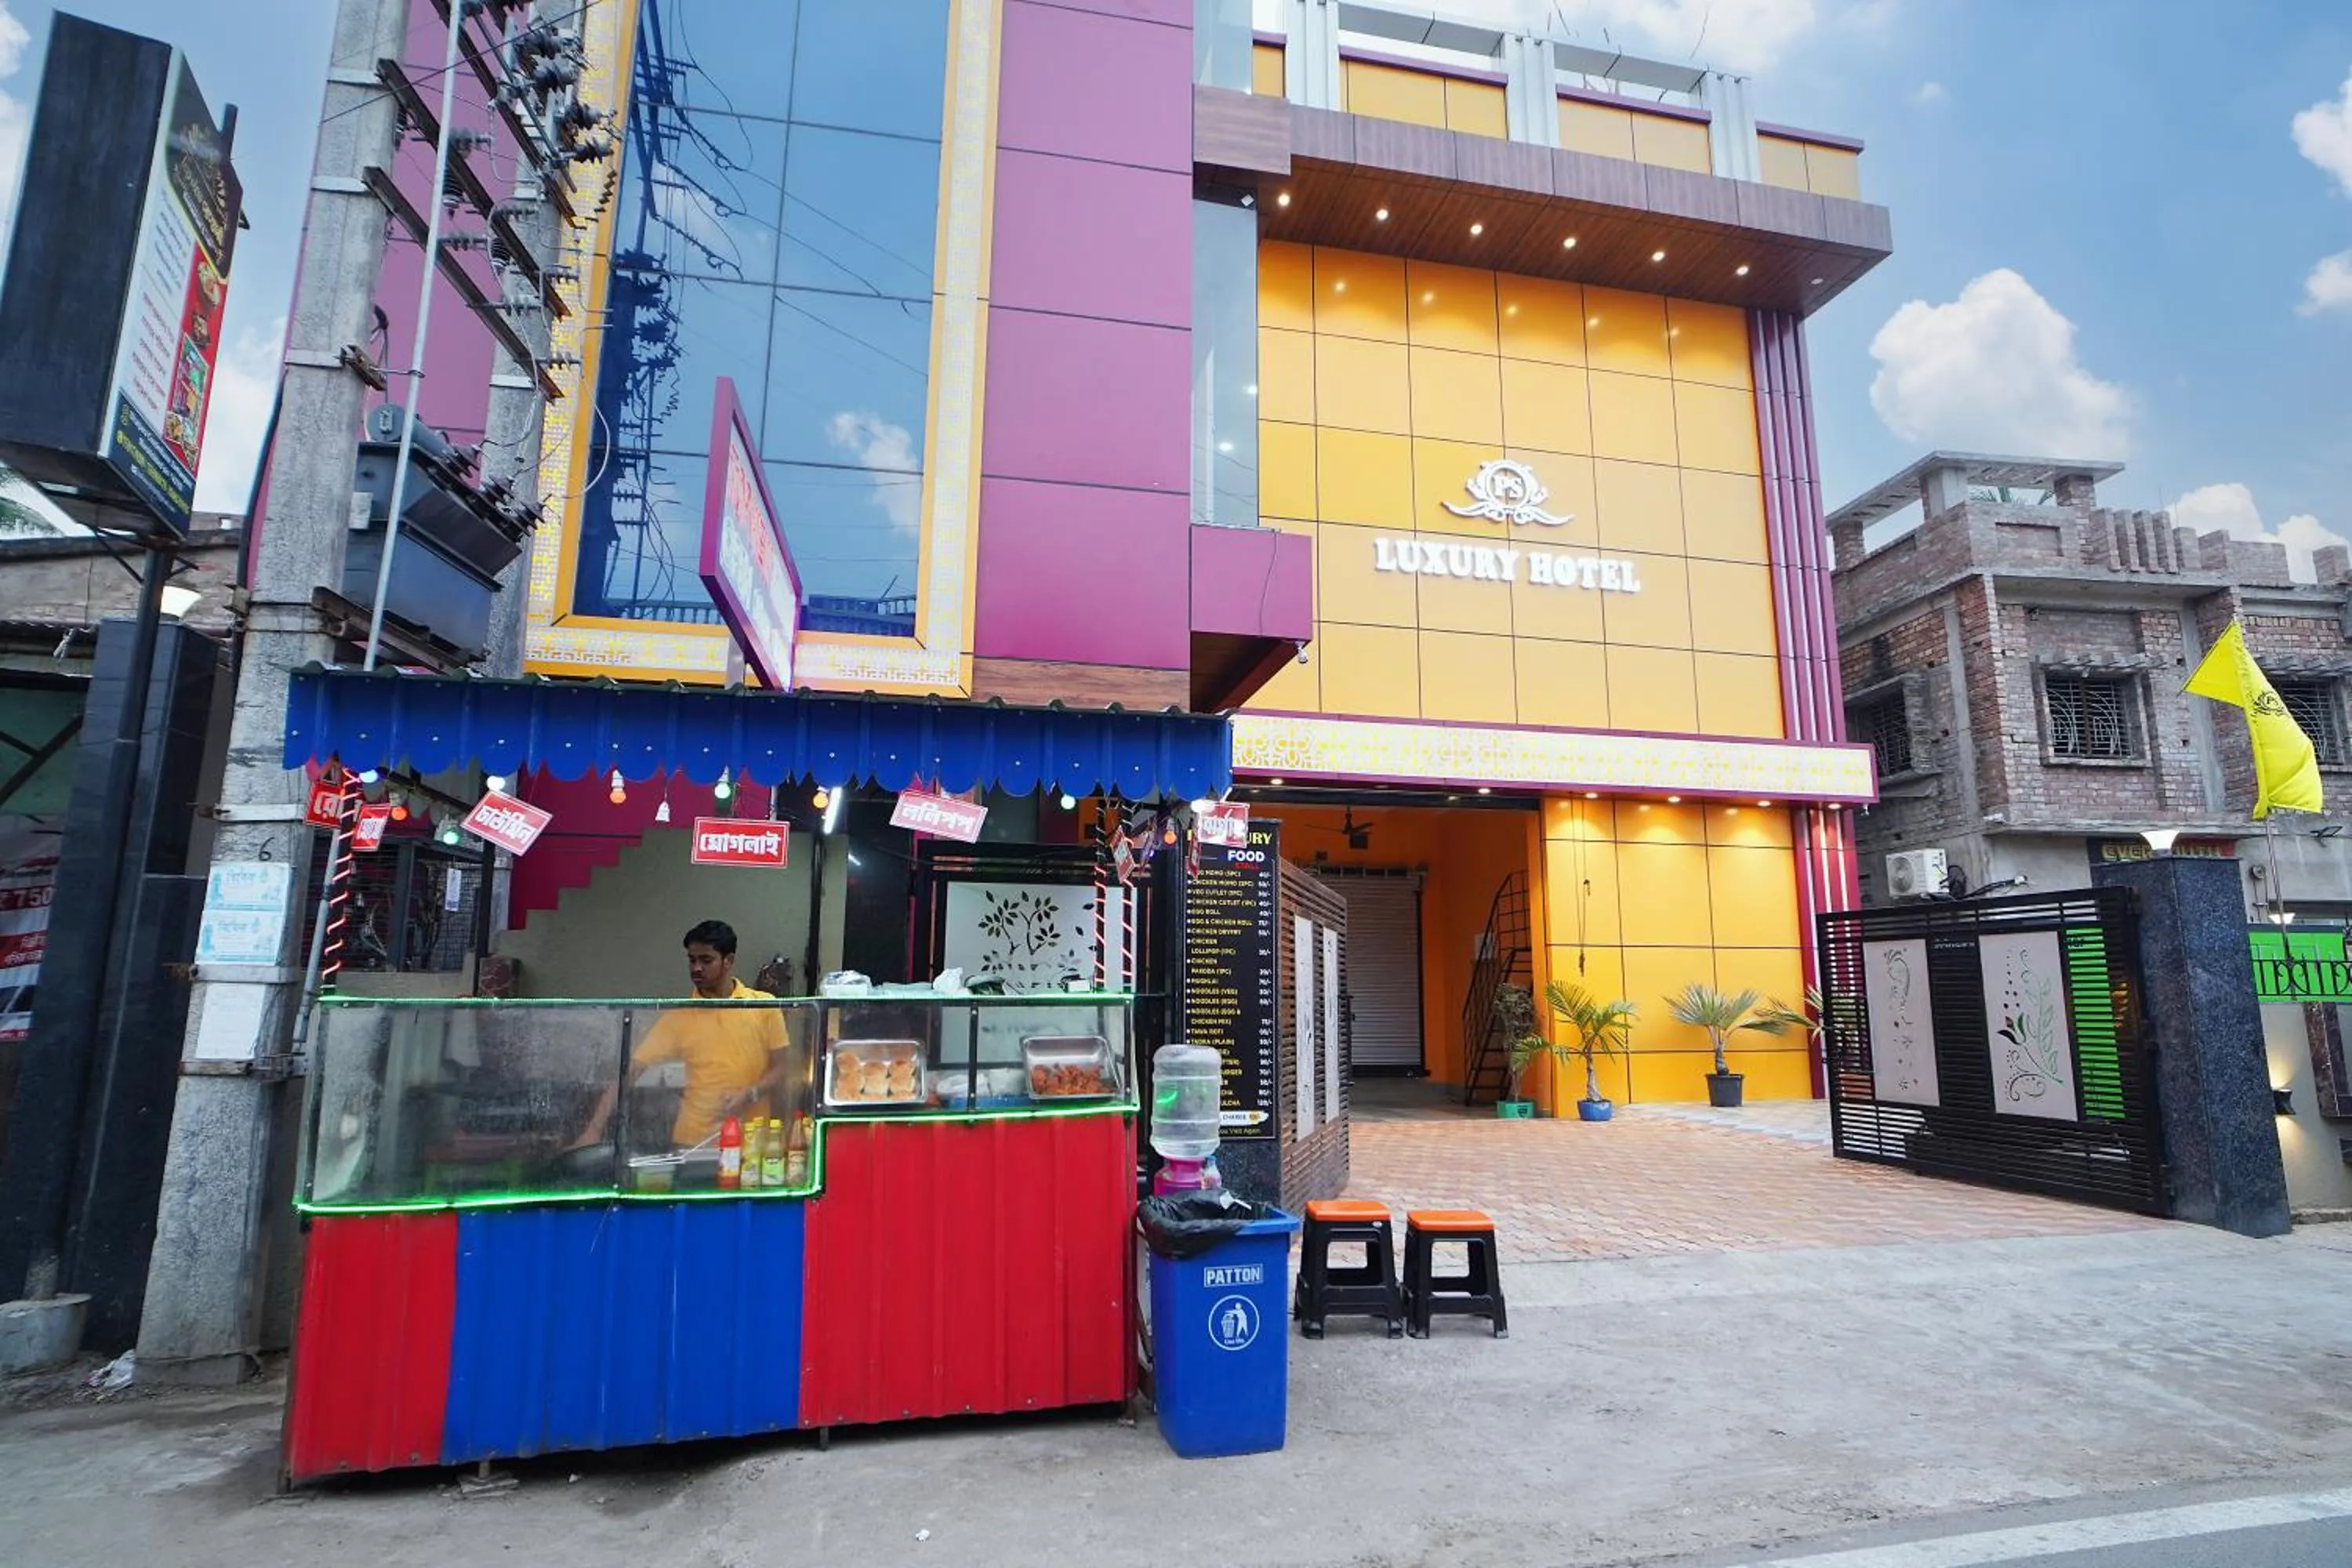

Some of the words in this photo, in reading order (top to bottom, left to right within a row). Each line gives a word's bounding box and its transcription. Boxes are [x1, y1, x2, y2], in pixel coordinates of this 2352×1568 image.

[1374, 538, 1519, 582] LUXURY
[1528, 552, 1641, 593] HOTEL
[699, 831, 782, 858] মোগলাই
[1227, 850, 1265, 862] FOOD
[13, 887, 53, 907] 750
[1207, 1266, 1261, 1285] PATTON
